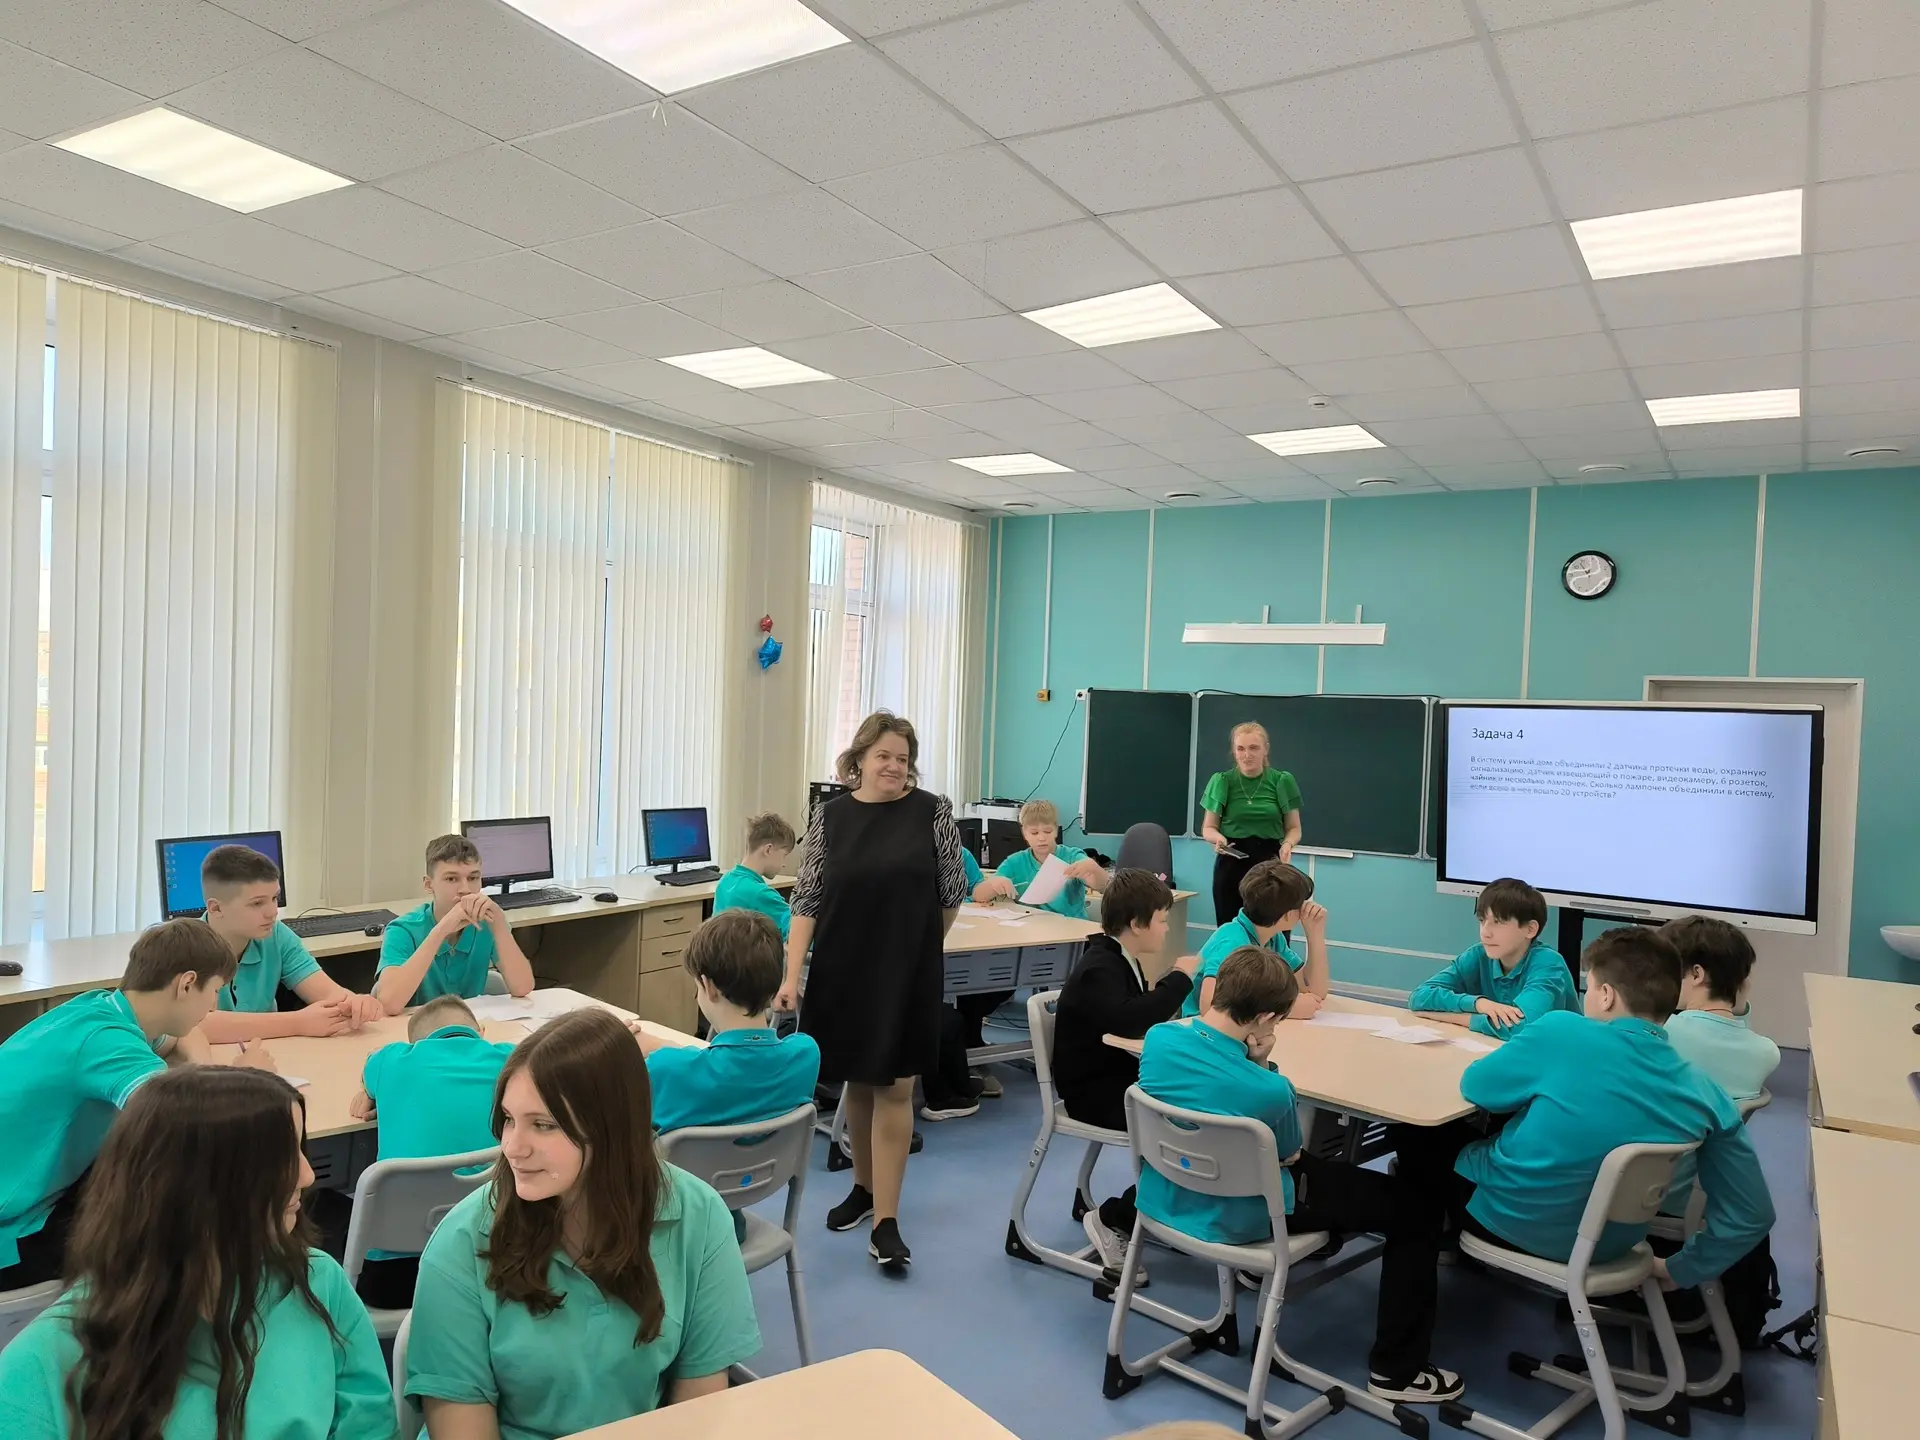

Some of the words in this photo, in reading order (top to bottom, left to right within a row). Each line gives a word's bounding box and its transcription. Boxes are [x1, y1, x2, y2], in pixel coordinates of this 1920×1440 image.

[1472, 728, 1513, 740] Задача
[1517, 730, 1524, 739] 4
[1477, 757, 1507, 765] систему
[1555, 759, 1605, 769] объединили
[1650, 765, 1690, 773] протечки
[1720, 768, 1767, 777] охранную
[1620, 774, 1655, 782] пожаре,
[1721, 777, 1727, 785] 6
[1729, 779, 1768, 788] розеток,
[1561, 788, 1571, 796] 20
[1572, 790, 1617, 799] устройств?
[1590, 781, 1623, 789] Сколько
[1625, 784, 1667, 792] лампочек
[1669, 785, 1725, 795] объединили
[1735, 789, 1775, 799] систему,
